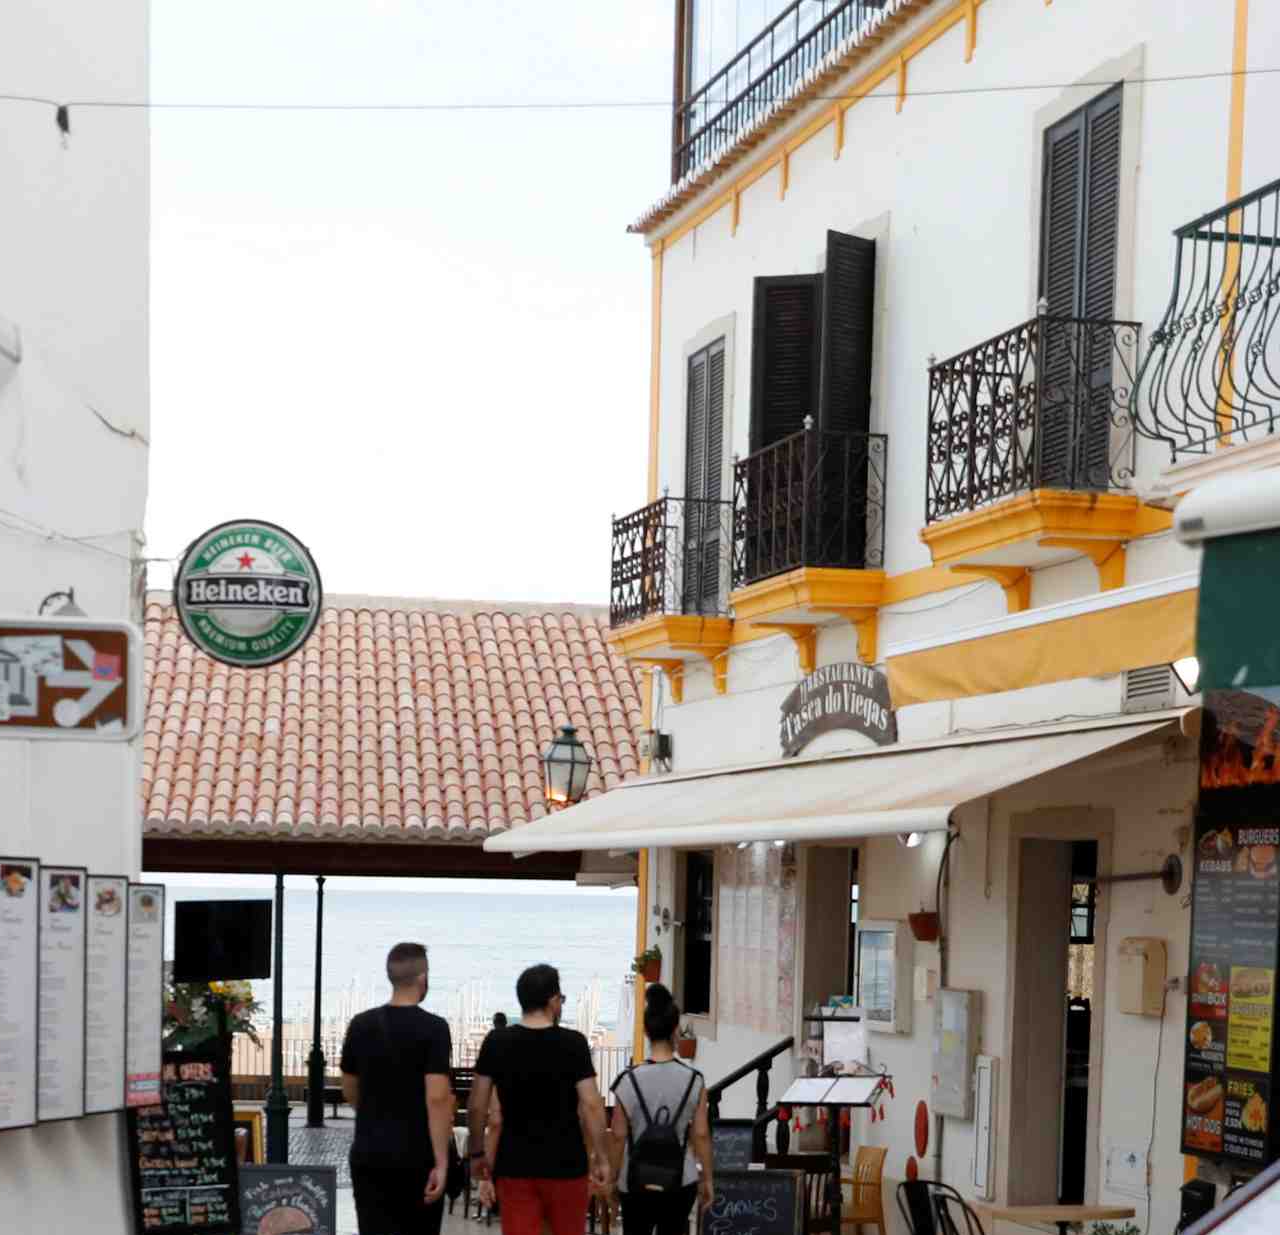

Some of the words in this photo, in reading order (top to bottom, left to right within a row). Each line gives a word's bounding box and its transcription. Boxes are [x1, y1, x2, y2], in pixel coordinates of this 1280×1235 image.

[190, 578, 305, 604] Heineken
[783, 696, 822, 743] Tasca
[825, 684, 841, 714] do
[842, 682, 888, 730] Viegas
[711, 1195, 777, 1222] CARNES
